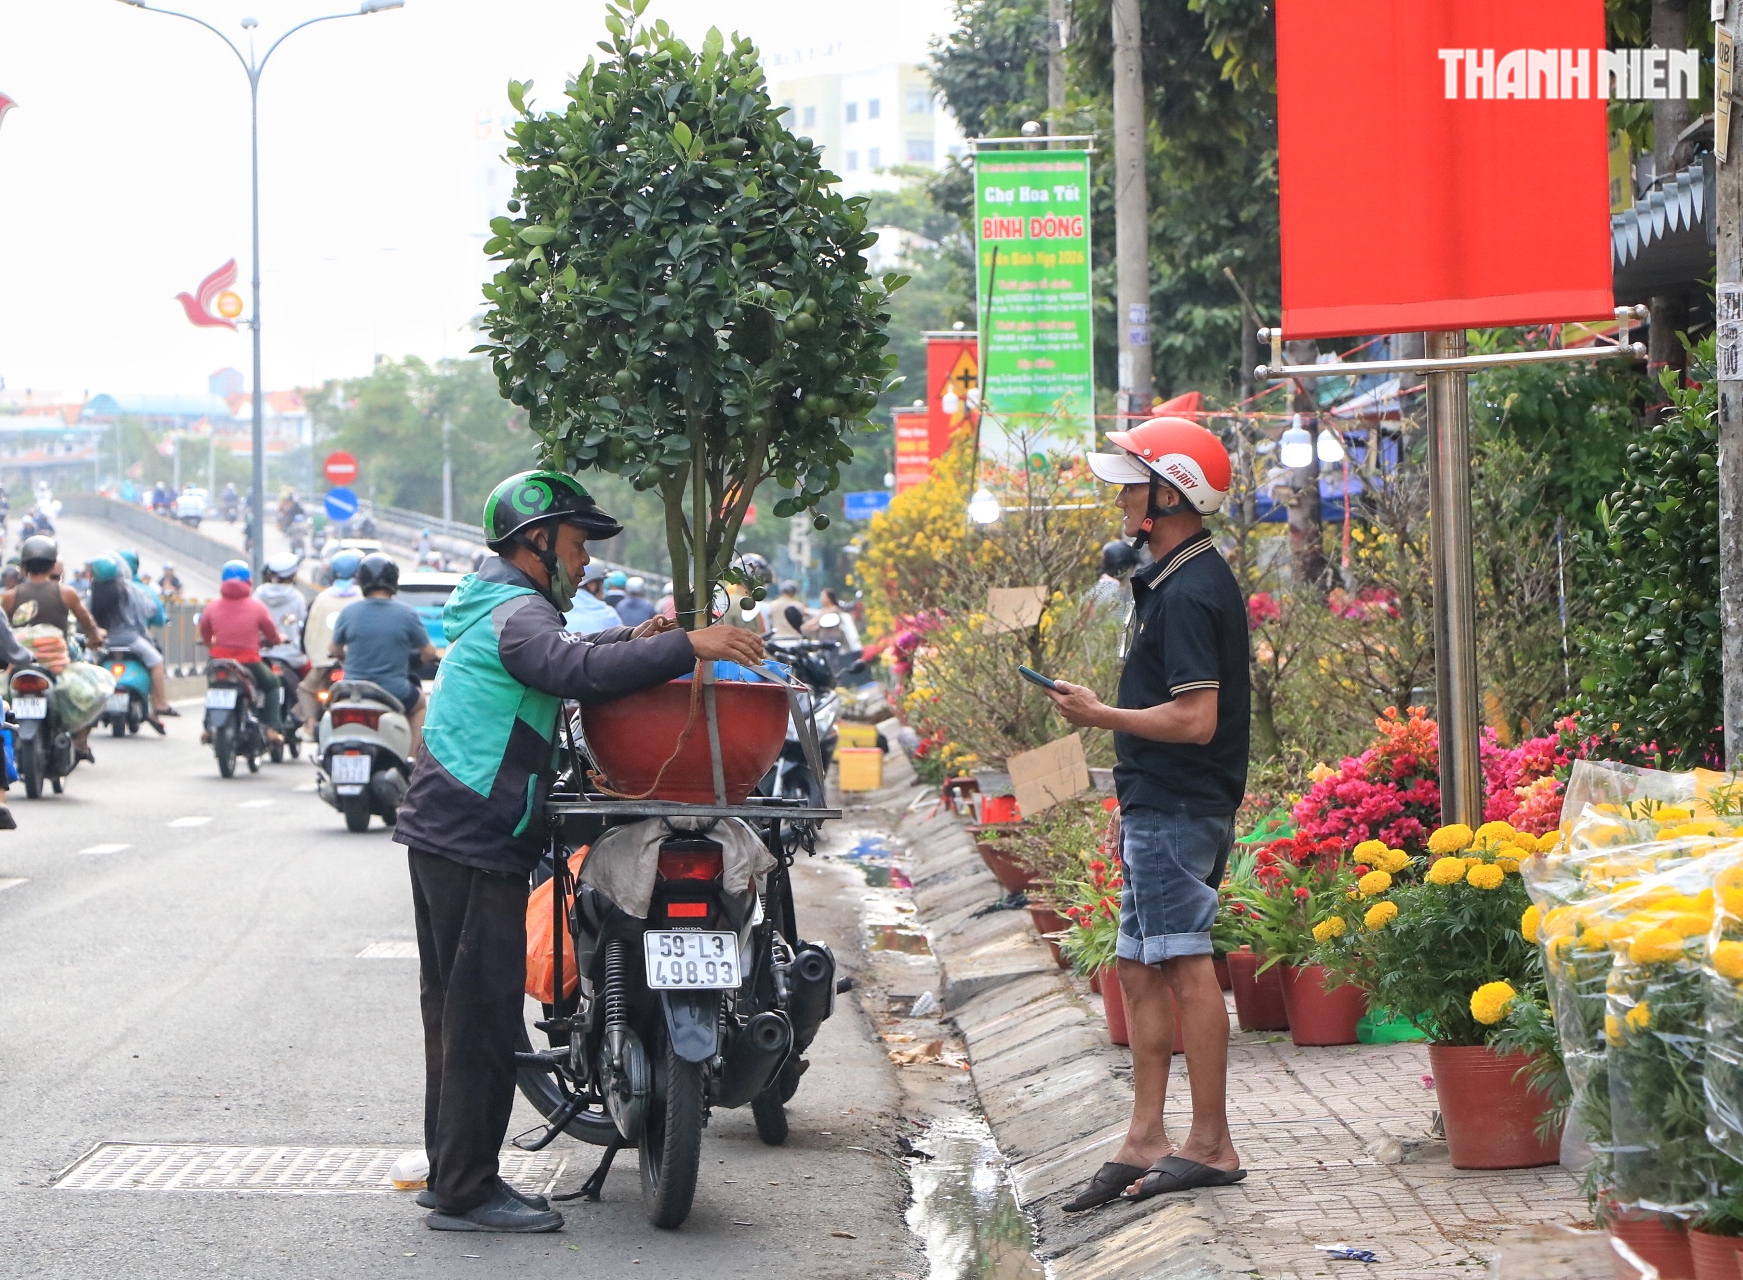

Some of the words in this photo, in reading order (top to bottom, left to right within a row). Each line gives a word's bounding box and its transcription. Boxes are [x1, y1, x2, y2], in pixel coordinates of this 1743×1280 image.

[985, 186, 1014, 207] Chợ
[1019, 186, 1049, 202] Hoa
[1053, 183, 1080, 202] Tết
[982, 212, 1024, 240] BÌNH
[1030, 211, 1084, 239] ĐÔNG
[659, 935, 724, 958] 59-L3
[656, 961, 733, 985] 498.93
